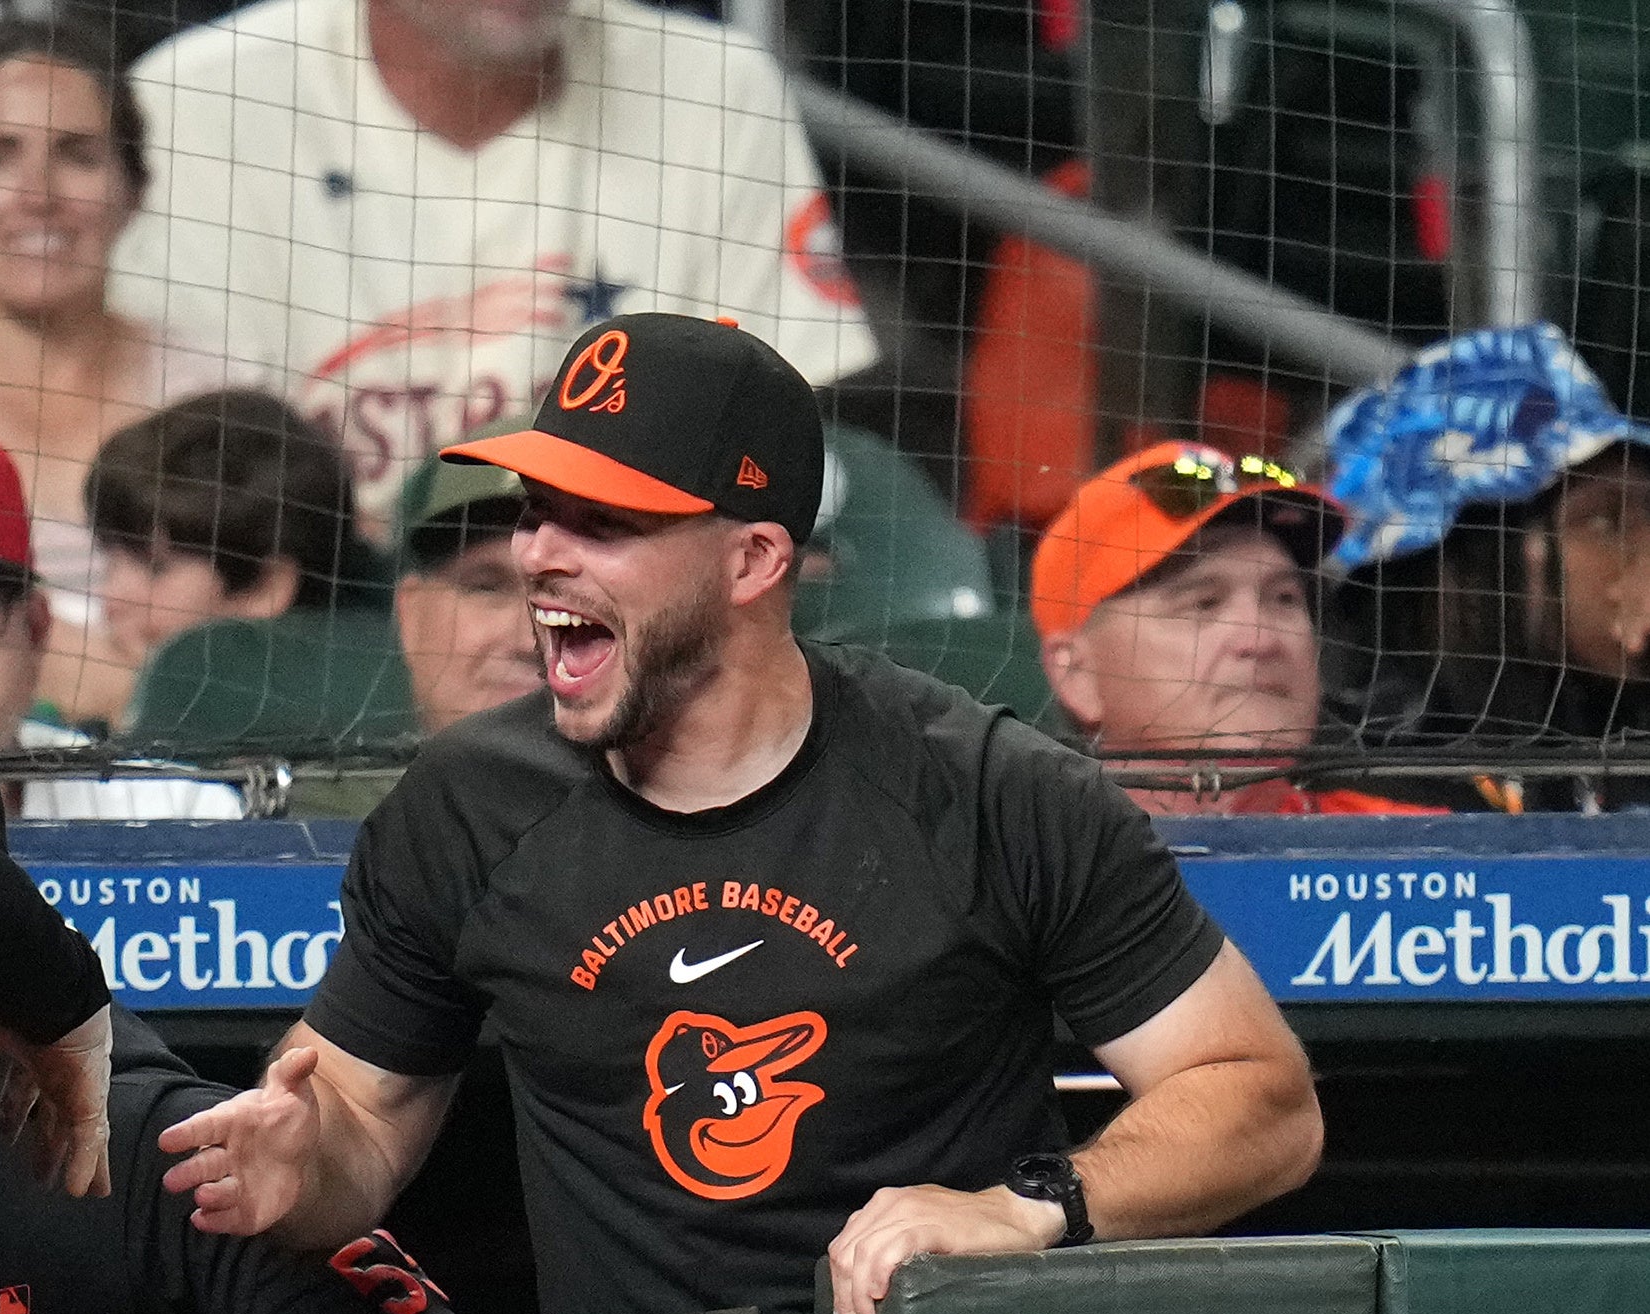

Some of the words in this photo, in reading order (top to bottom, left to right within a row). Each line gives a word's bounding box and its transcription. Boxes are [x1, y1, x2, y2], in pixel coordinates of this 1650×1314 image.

[558, 329, 629, 414] O's
[39, 876, 201, 906] OUSTON
[1289, 872, 1477, 901] HOUSTON
[570, 882, 709, 991] BALTIMORE
[721, 881, 859, 969] BASEBALL
[1290, 893, 1650, 987] Method
